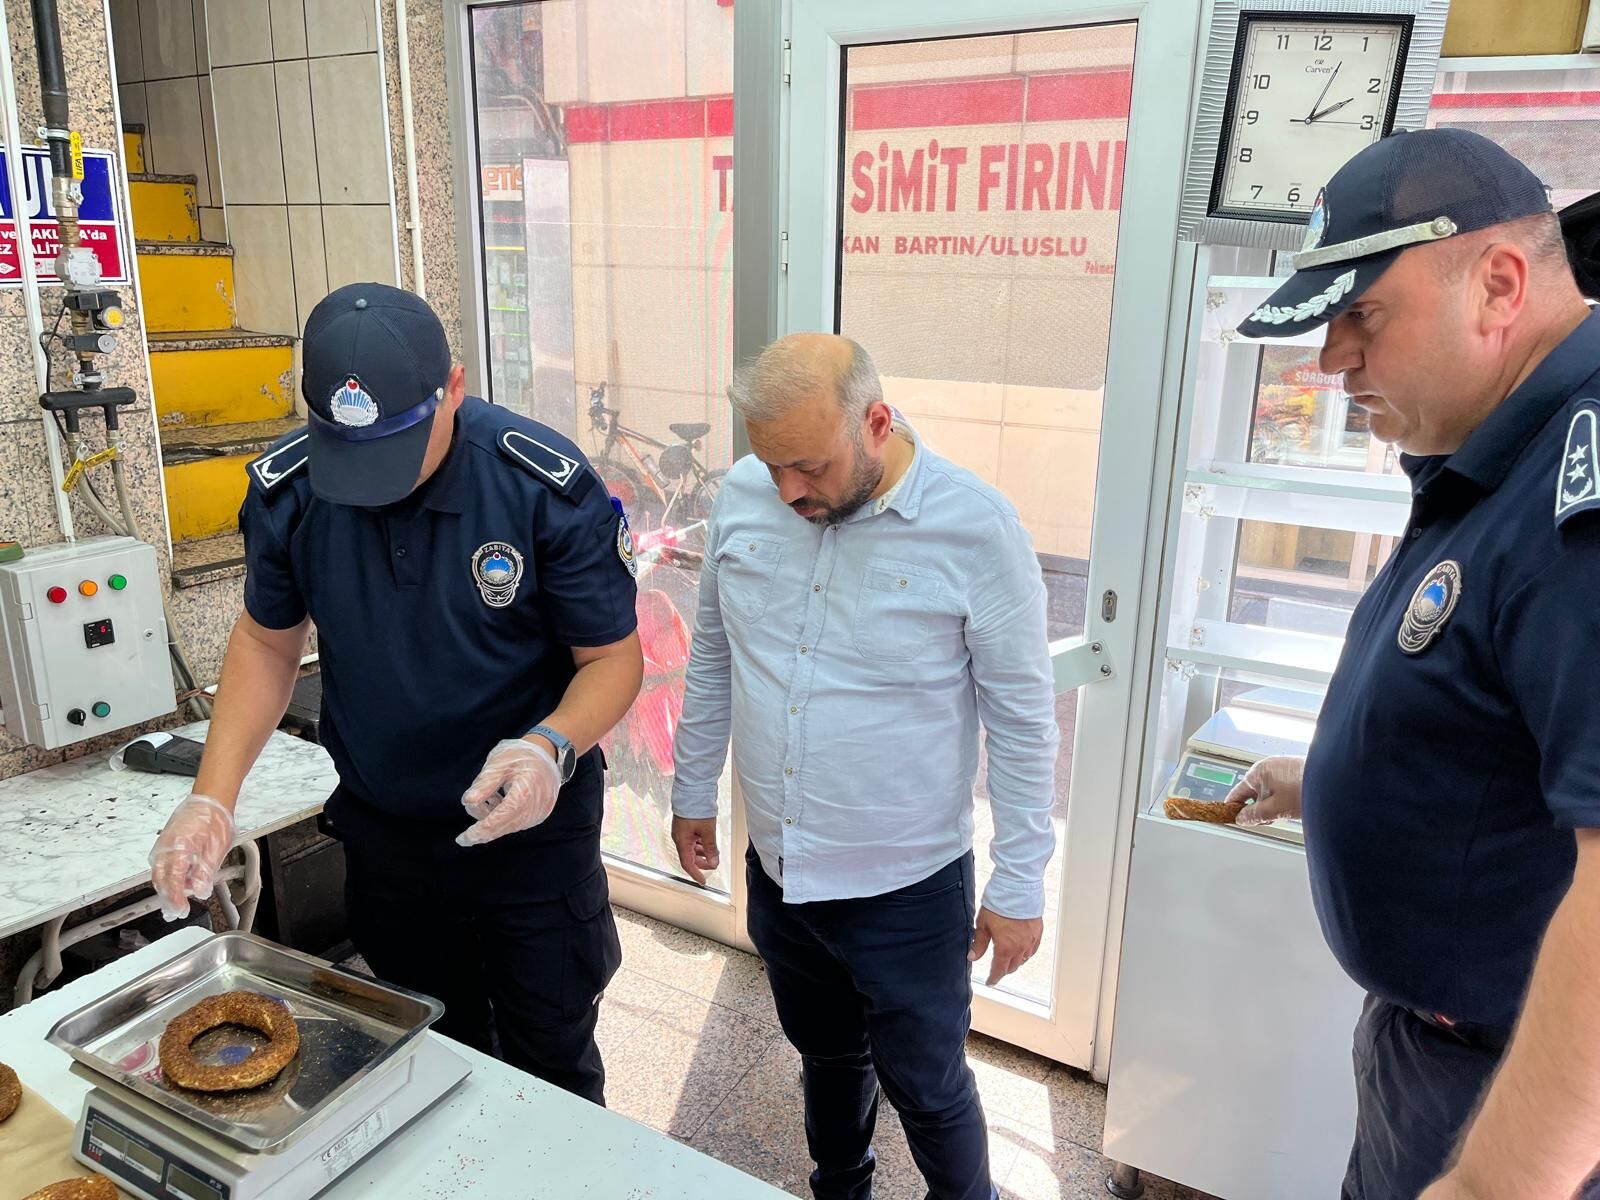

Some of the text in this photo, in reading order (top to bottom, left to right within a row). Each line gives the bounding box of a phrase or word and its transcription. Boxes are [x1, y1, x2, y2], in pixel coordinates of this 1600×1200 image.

[1276, 34, 1290, 50] 11
[1313, 35, 1333, 51] 12
[1361, 36, 1369, 52] 1
[1253, 74, 1271, 90] 10
[1366, 78, 1381, 94] 2
[1246, 110, 1259, 125] 9
[1360, 115, 1374, 130] 3
[1239, 147, 1253, 163] 8
[1250, 185, 1263, 200] 7
[1287, 187, 1300, 202] 6
[894, 234, 1087, 257] BARTIN/ULUSLU
